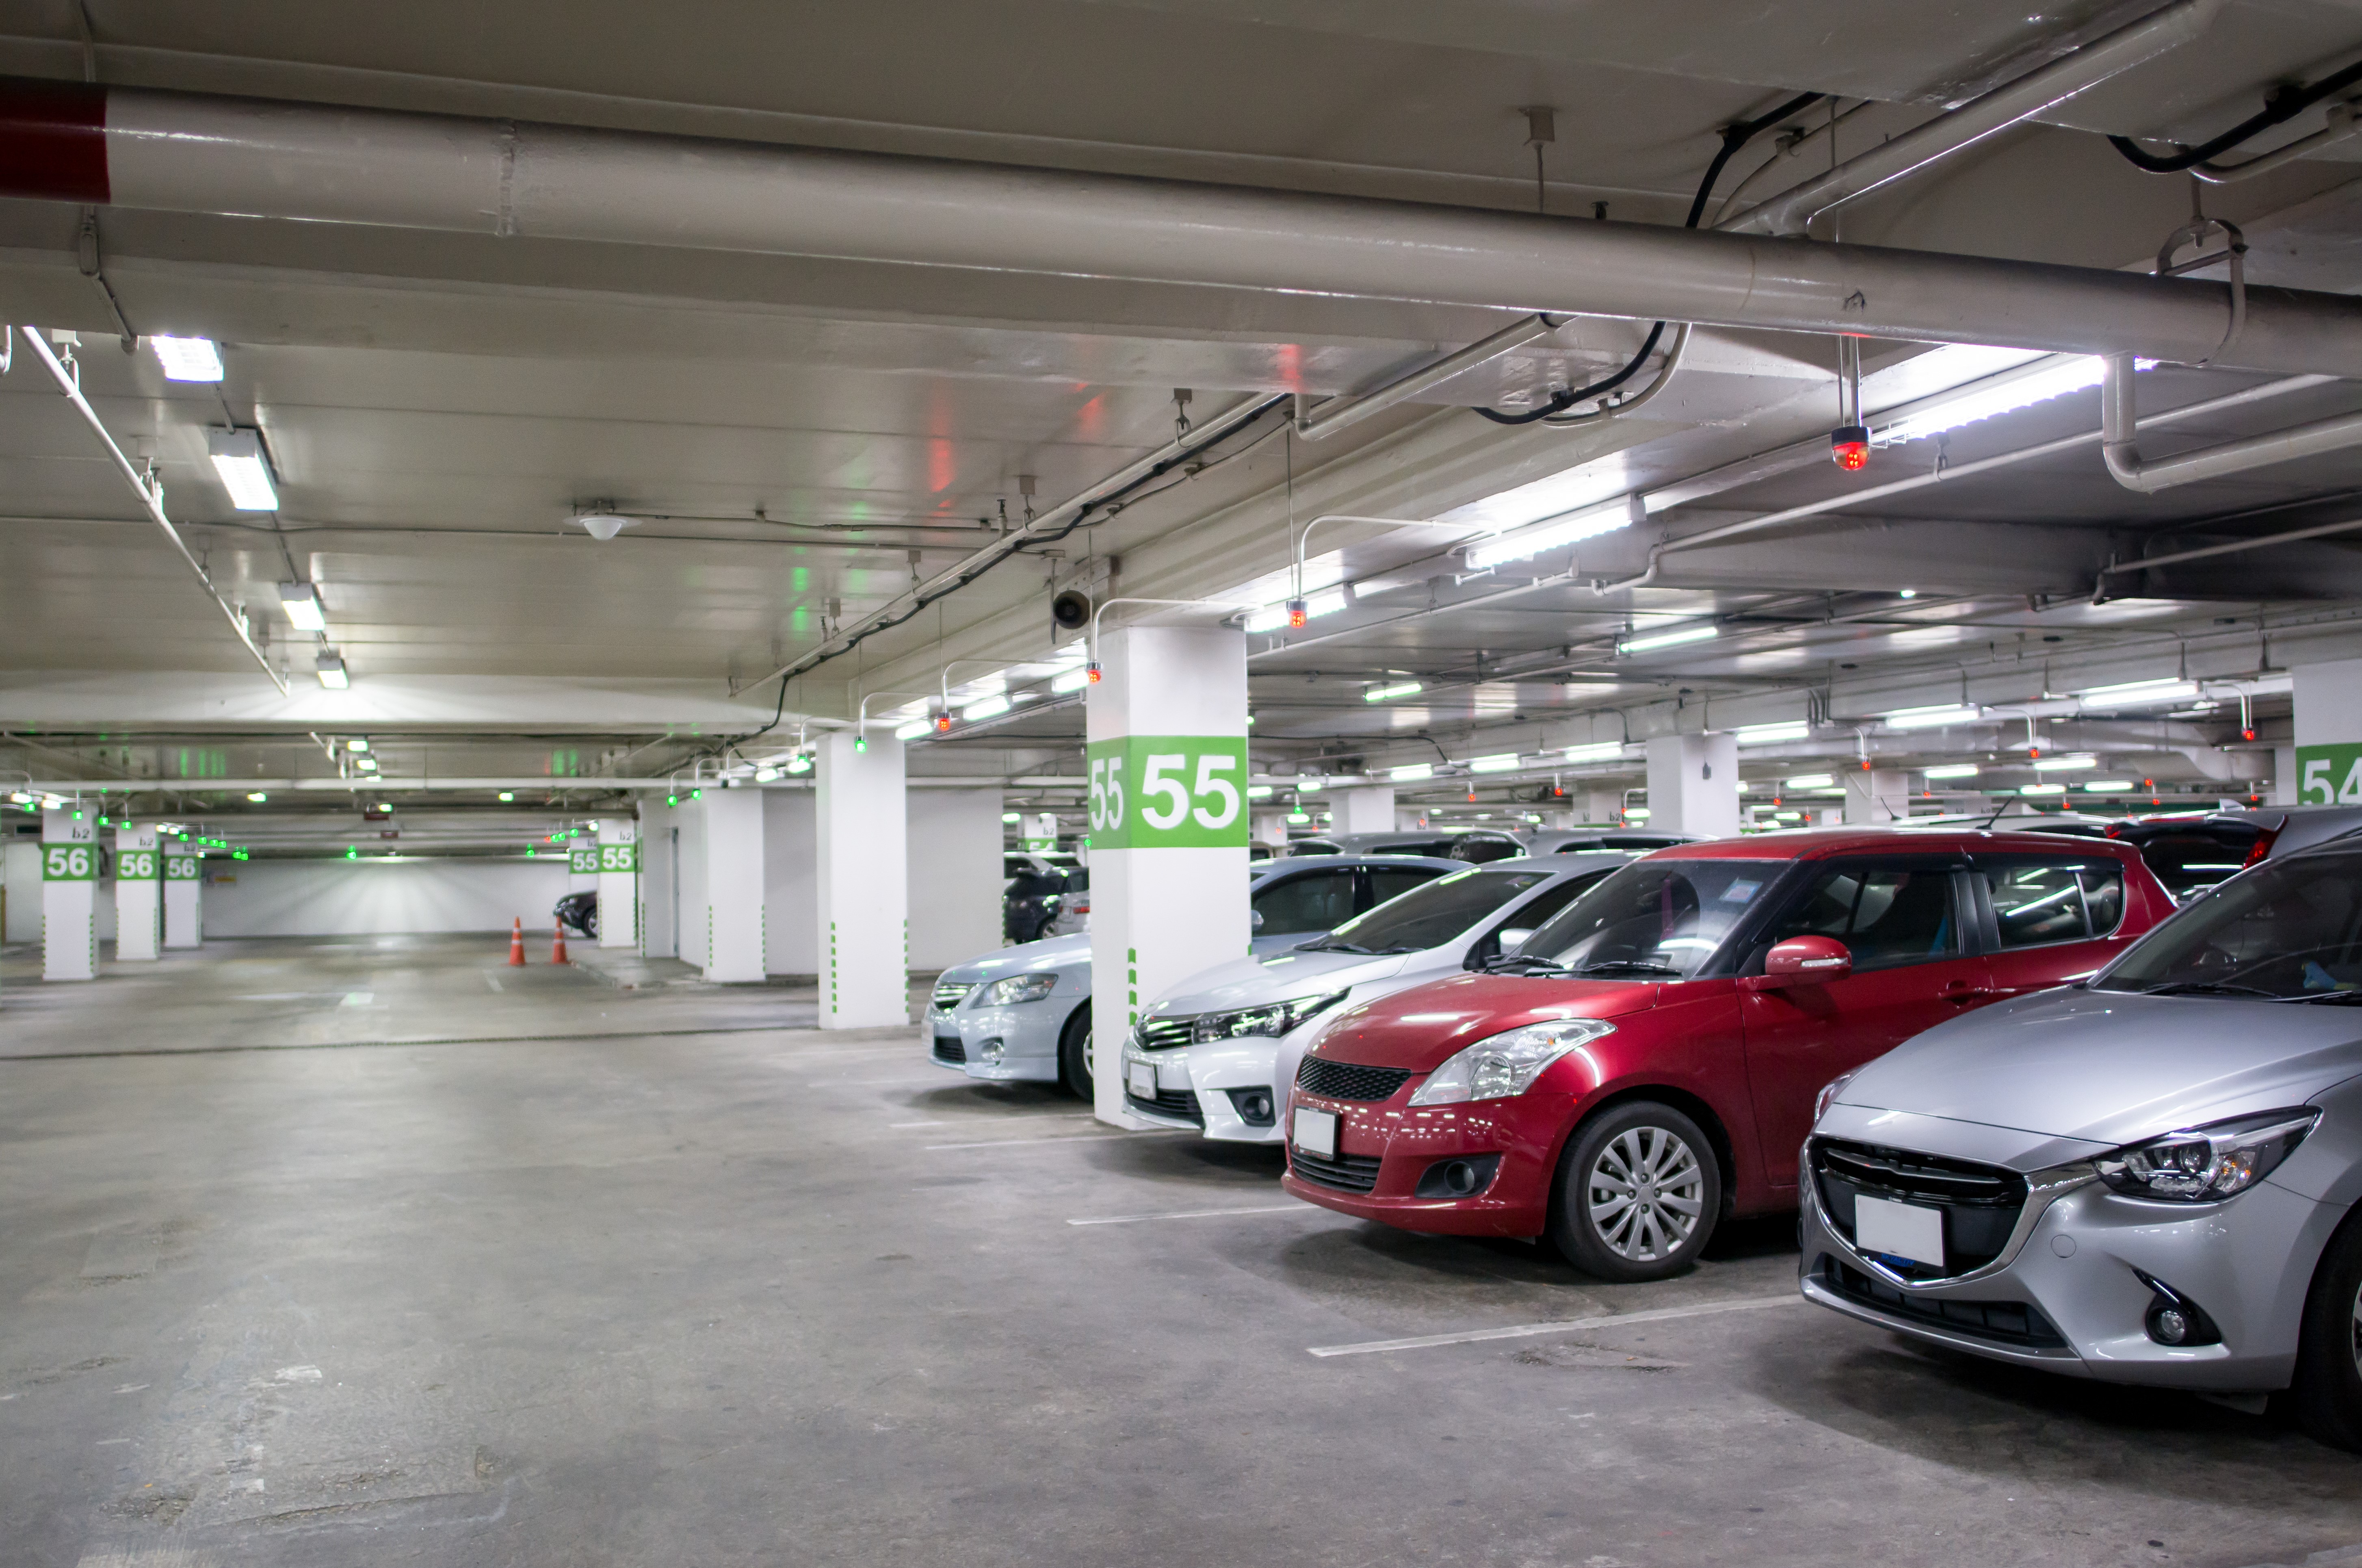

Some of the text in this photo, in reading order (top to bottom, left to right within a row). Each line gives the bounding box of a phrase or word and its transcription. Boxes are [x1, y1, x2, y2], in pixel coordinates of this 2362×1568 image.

[2304, 757, 2362, 805] 54
[1090, 756, 1123, 831] 55
[1142, 754, 1240, 829] 55
[1610, 811, 1620, 821] b2
[72, 827, 90, 839] b2
[140, 836, 154, 846] b2
[620, 831, 632, 840] b2
[1043, 827, 1054, 835] b2
[48, 848, 89, 877] 56
[121, 853, 153, 877] 56
[168, 858, 196, 878] 56
[573, 853, 598, 871] 55
[603, 847, 632, 869] 55
